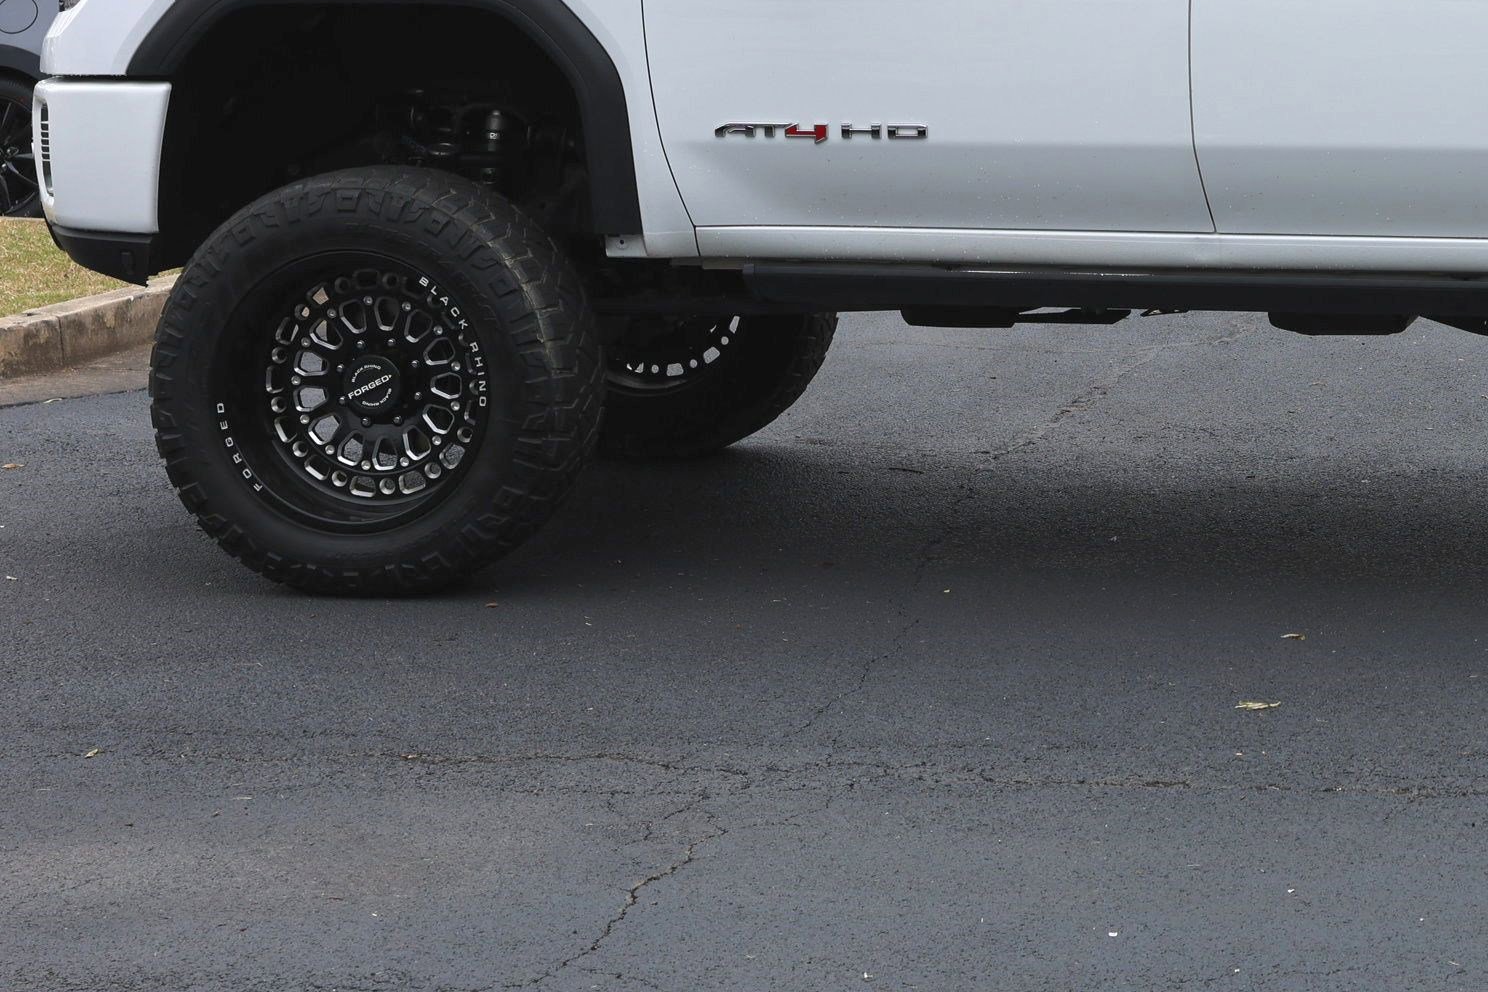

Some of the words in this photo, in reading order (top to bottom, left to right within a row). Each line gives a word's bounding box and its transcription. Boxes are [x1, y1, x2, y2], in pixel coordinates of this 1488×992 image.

[715, 122, 829, 145] AT4
[841, 122, 928, 139] HD
[419, 276, 468, 330] BLACK
[469, 341, 487, 407] RHINO
[347, 374, 390, 399] FORGED
[216, 402, 263, 492] FORGED
